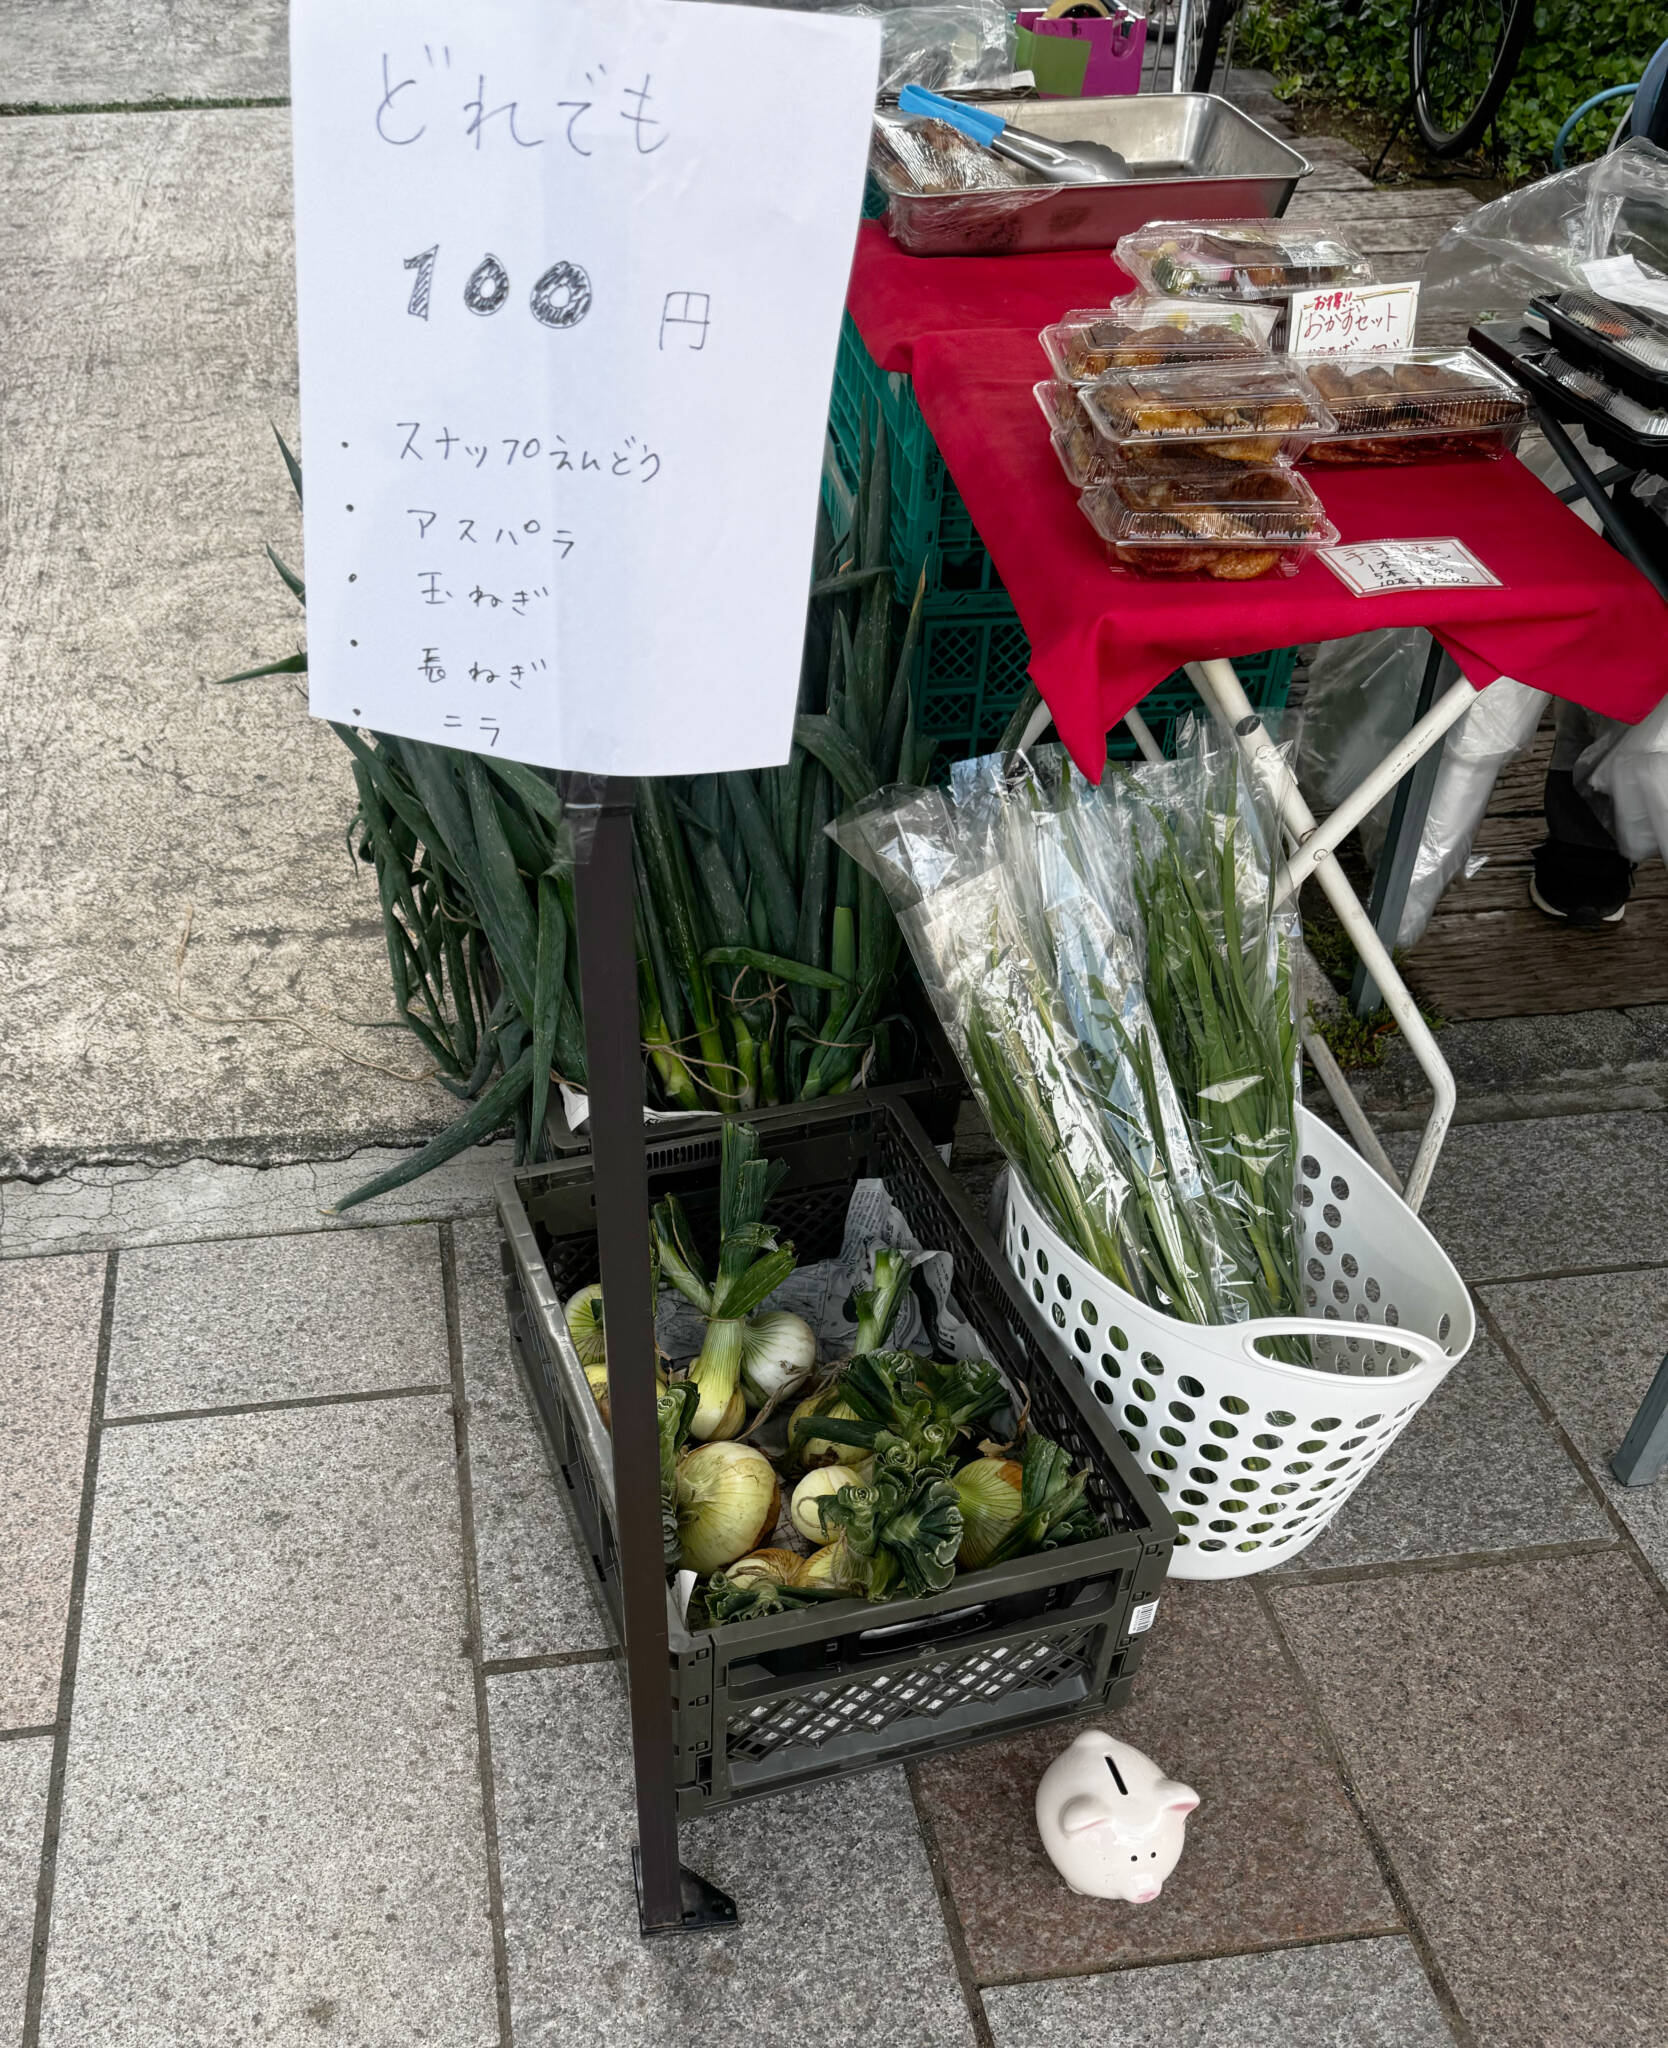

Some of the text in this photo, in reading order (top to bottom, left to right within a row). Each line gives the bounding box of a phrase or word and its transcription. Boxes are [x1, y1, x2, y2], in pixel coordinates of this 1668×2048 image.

[376, 46, 669, 156] どれでも
[1303, 299, 1399, 340] おかずセット
[396, 421, 662, 483] スナップえんどう
[407, 510, 575, 559] アスパラ
[417, 571, 549, 617] 玉ねぎ
[417, 647, 547, 690] 長ねぎ
[443, 714, 501, 748] ニラ
